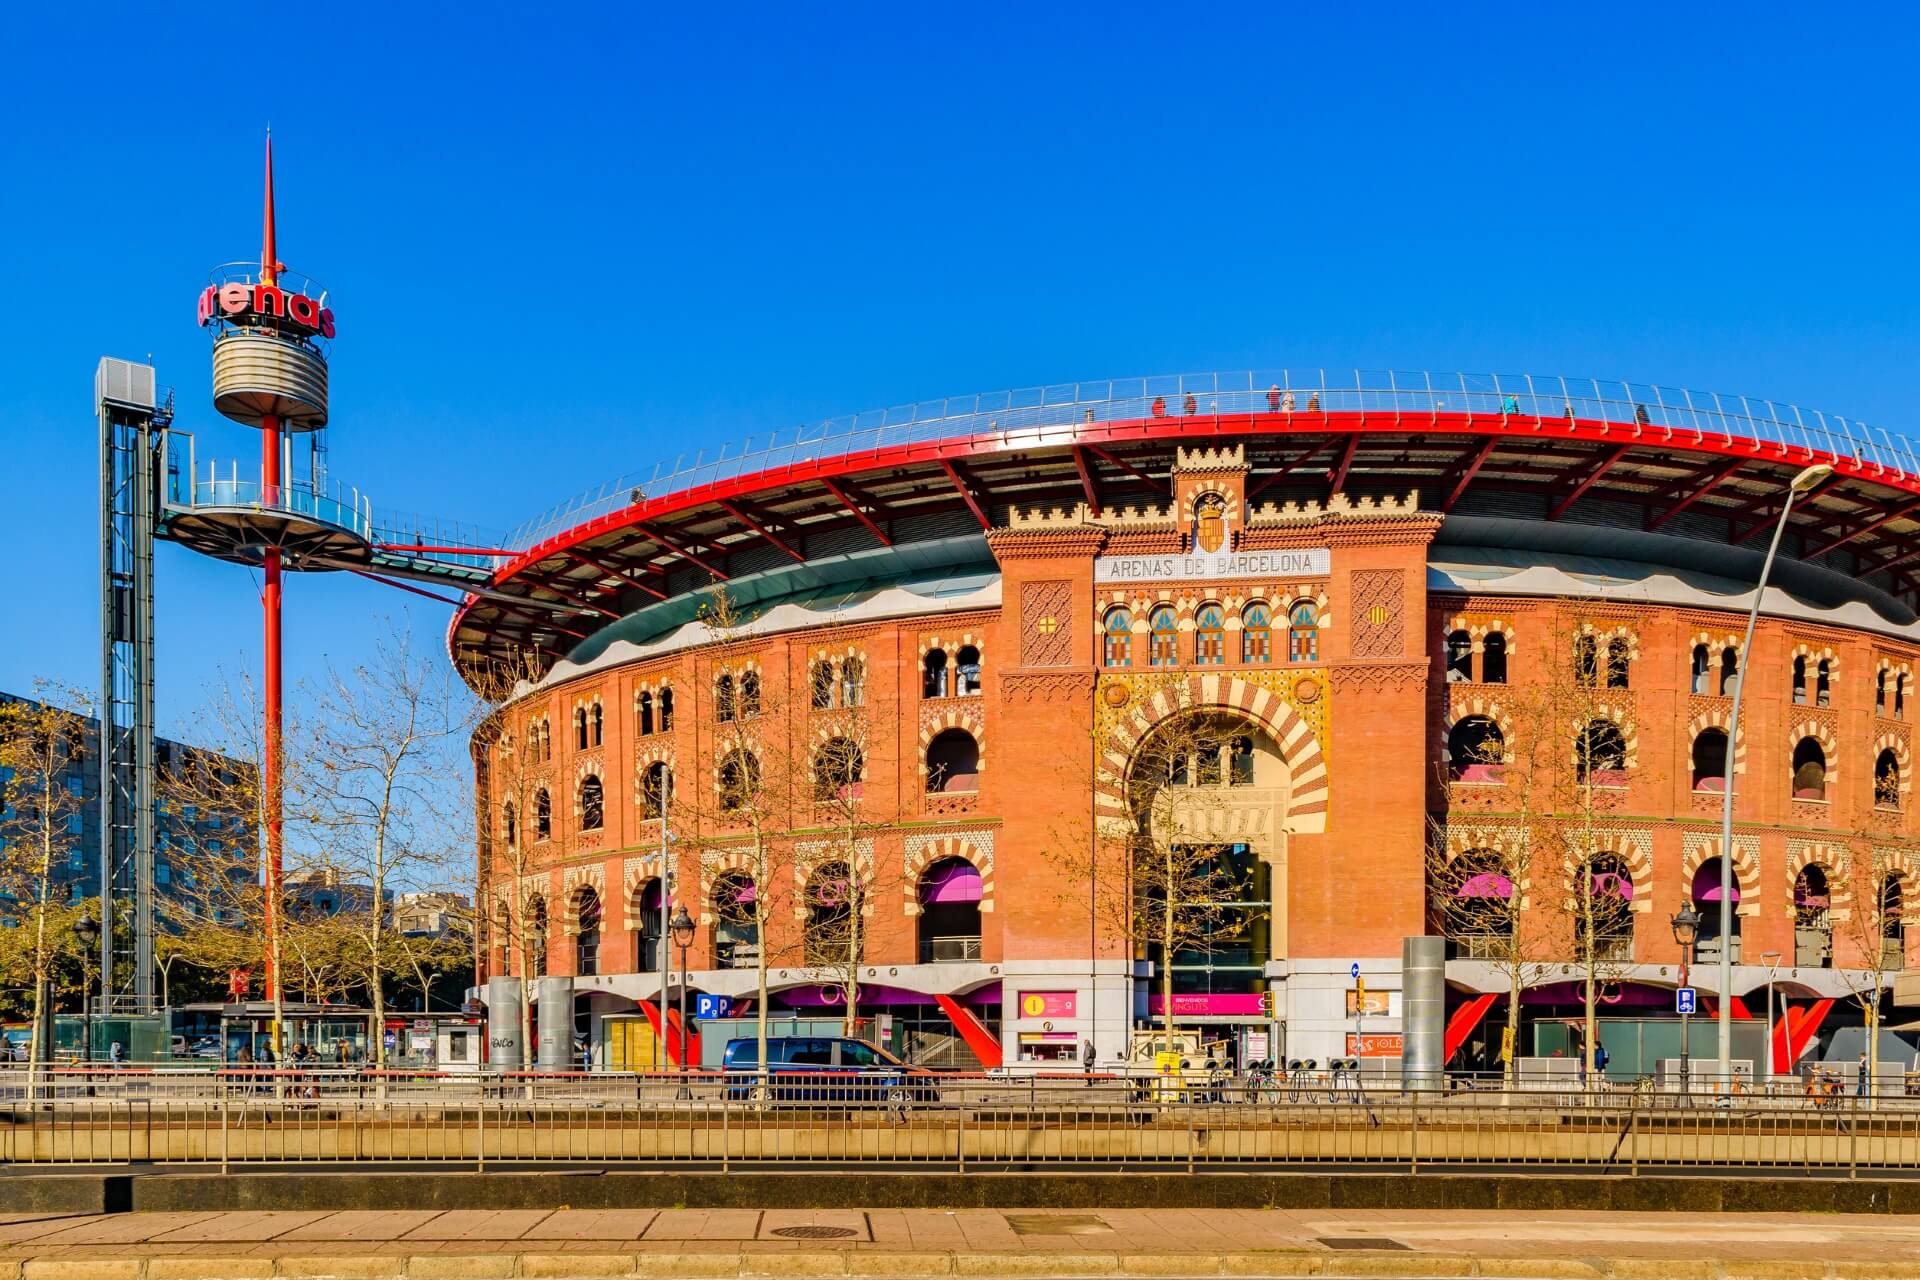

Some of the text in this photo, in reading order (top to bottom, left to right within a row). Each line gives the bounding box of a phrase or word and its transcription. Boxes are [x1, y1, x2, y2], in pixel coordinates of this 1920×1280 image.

[197, 281, 336, 339] arenas
[1110, 554, 1313, 577] ARENAS DE BARCELONA
[701, 998, 711, 1015] P
[720, 999, 727, 1015] P
